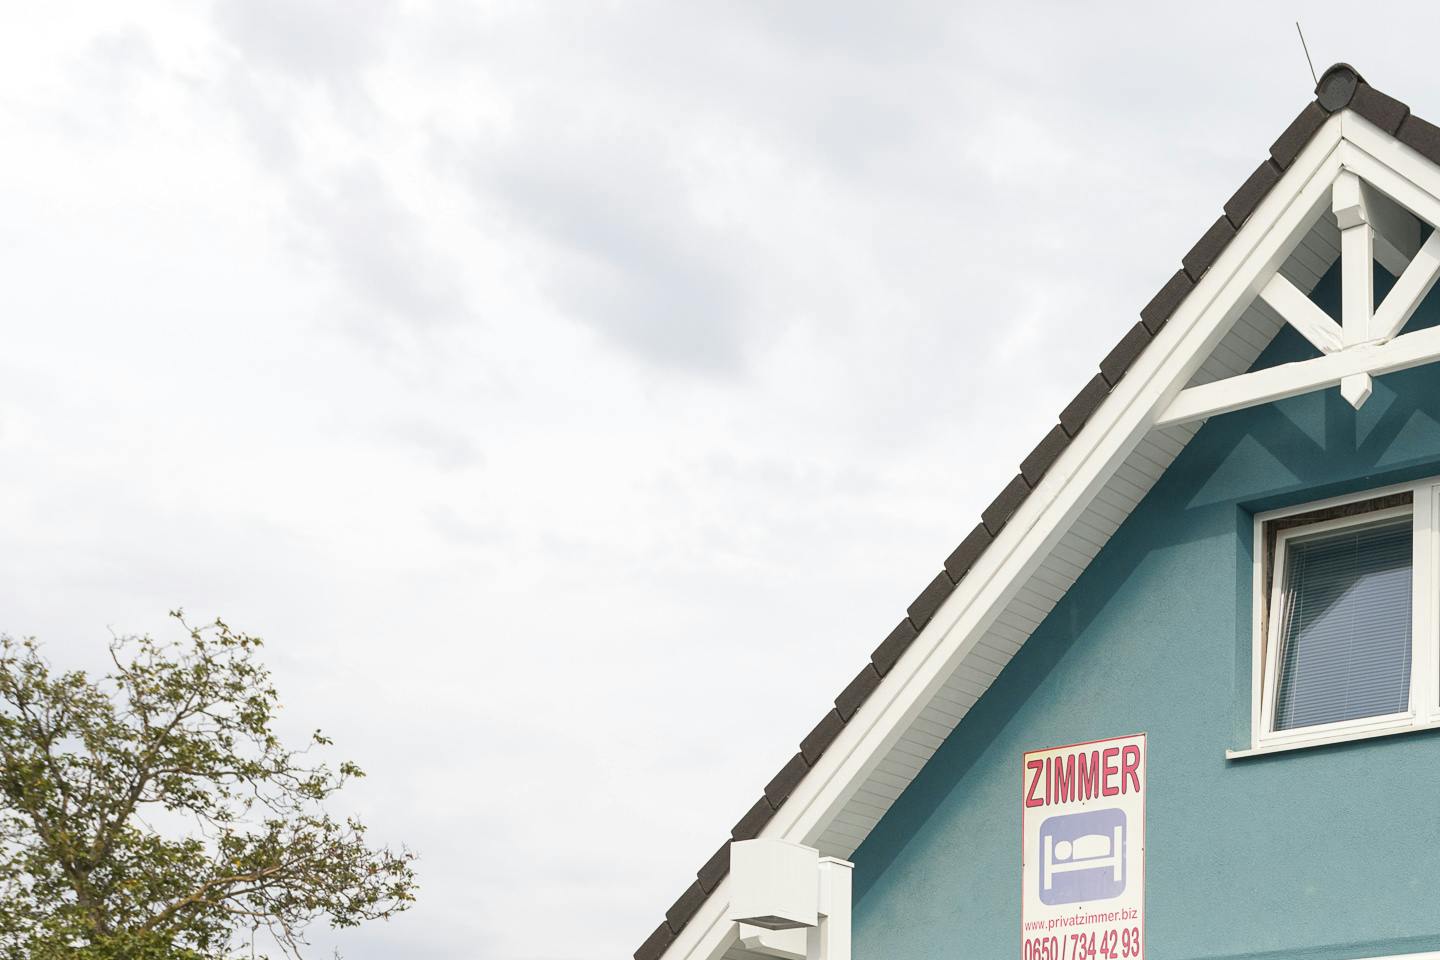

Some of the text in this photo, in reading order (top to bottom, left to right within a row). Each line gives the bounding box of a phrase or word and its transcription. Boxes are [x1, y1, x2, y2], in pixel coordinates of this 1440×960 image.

[1025, 744, 1141, 808] ZIMMER
[1024, 907, 1138, 932] www.privatzimmer.biz
[1099, 929, 1118, 960] 42
[1121, 926, 1140, 958] 93
